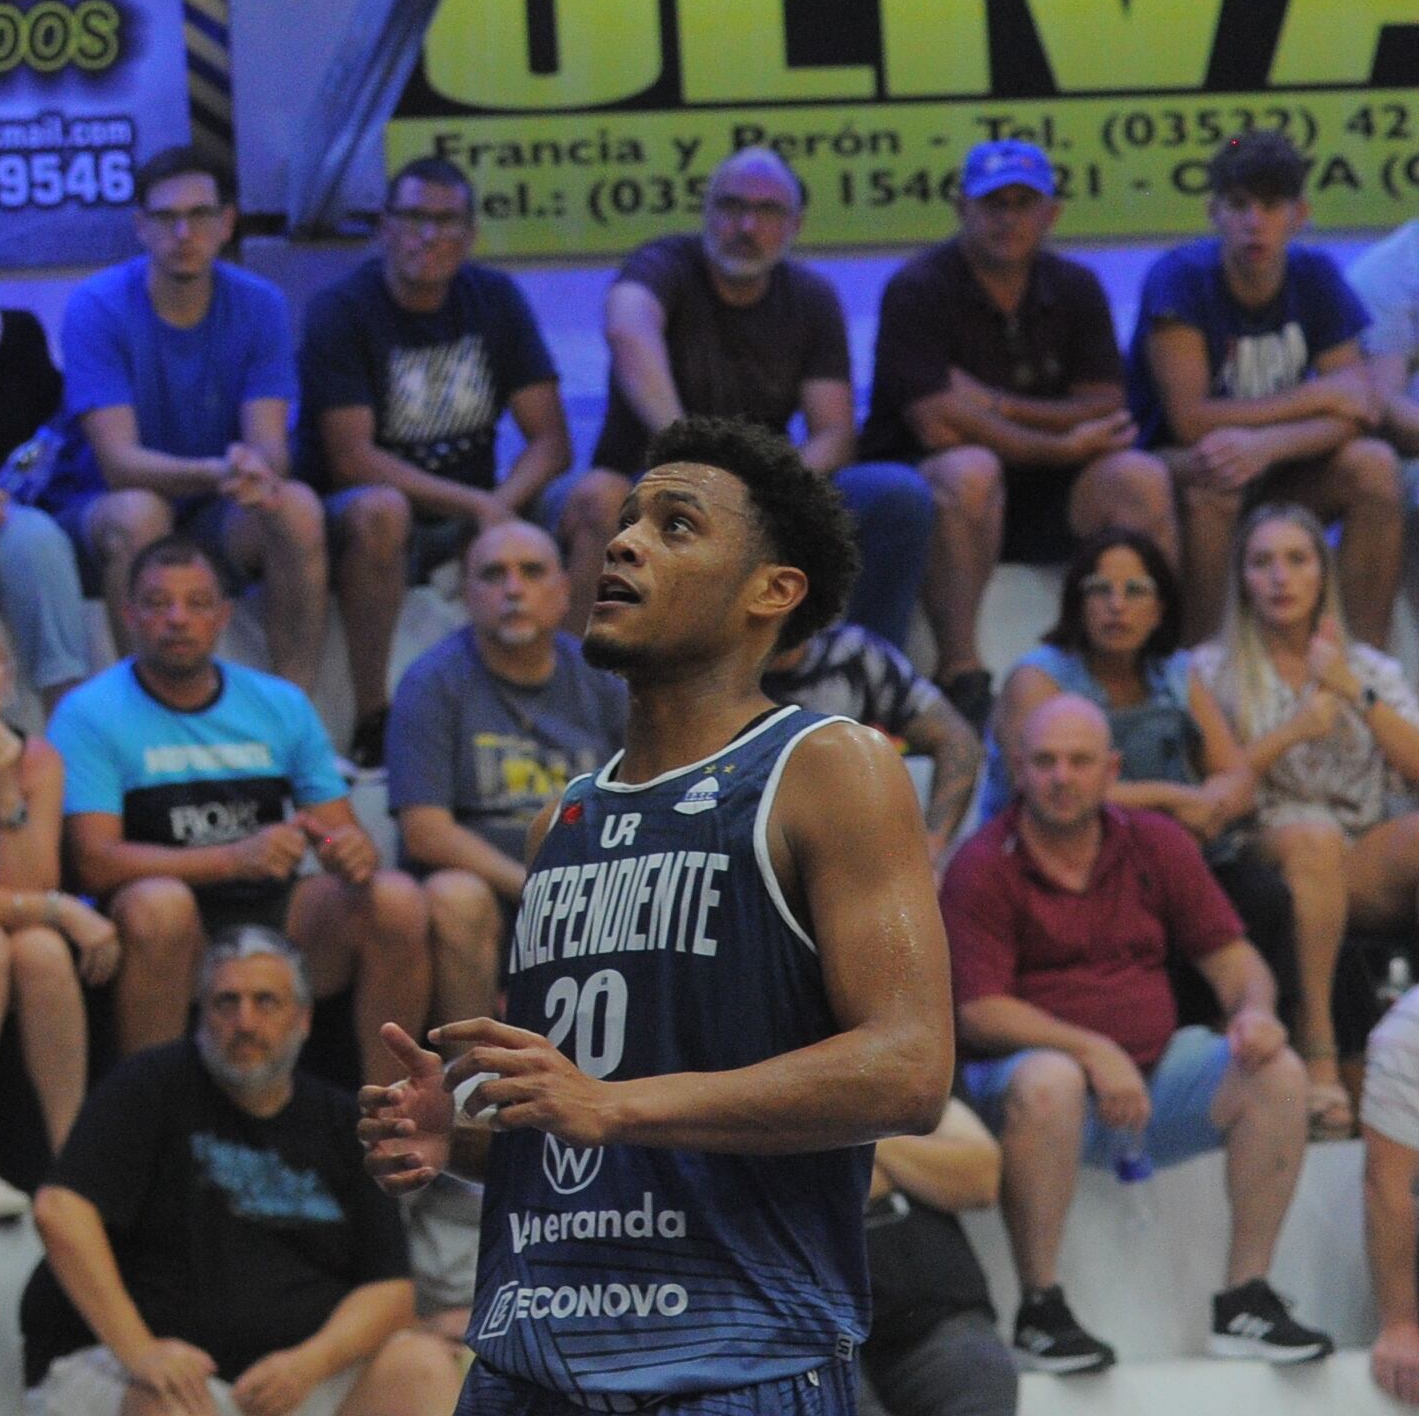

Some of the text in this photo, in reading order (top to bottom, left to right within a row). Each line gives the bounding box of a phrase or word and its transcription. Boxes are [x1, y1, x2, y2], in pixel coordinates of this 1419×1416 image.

[671, 135, 703, 172] y
[600, 812, 643, 849] UR
[544, 968, 629, 1079] 20
[515, 1282, 690, 1320] ECONOVO
